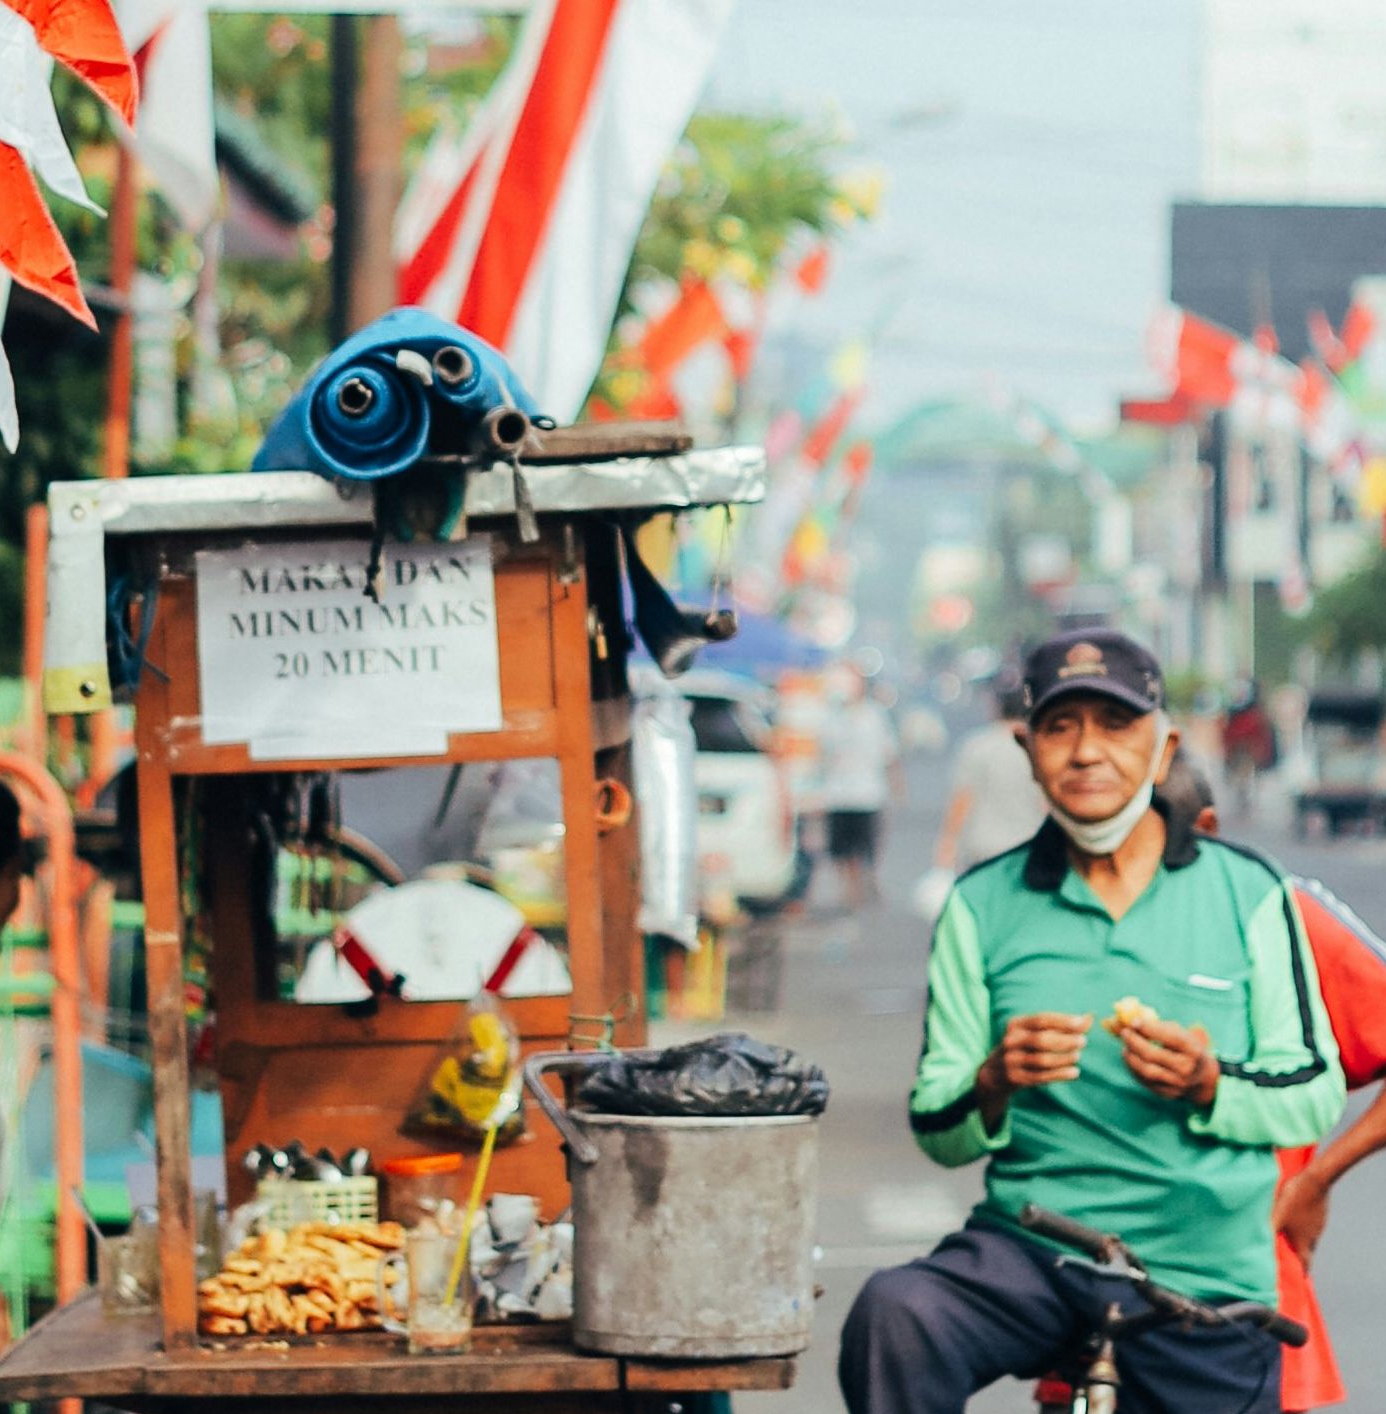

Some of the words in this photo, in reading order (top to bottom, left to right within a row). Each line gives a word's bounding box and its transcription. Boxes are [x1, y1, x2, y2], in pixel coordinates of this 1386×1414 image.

[395, 555, 469, 586] DAN
[229, 604, 364, 639] MINUM
[378, 599, 488, 629] MAKS
[275, 652, 309, 679] 20
[322, 646, 444, 677] MENIT
